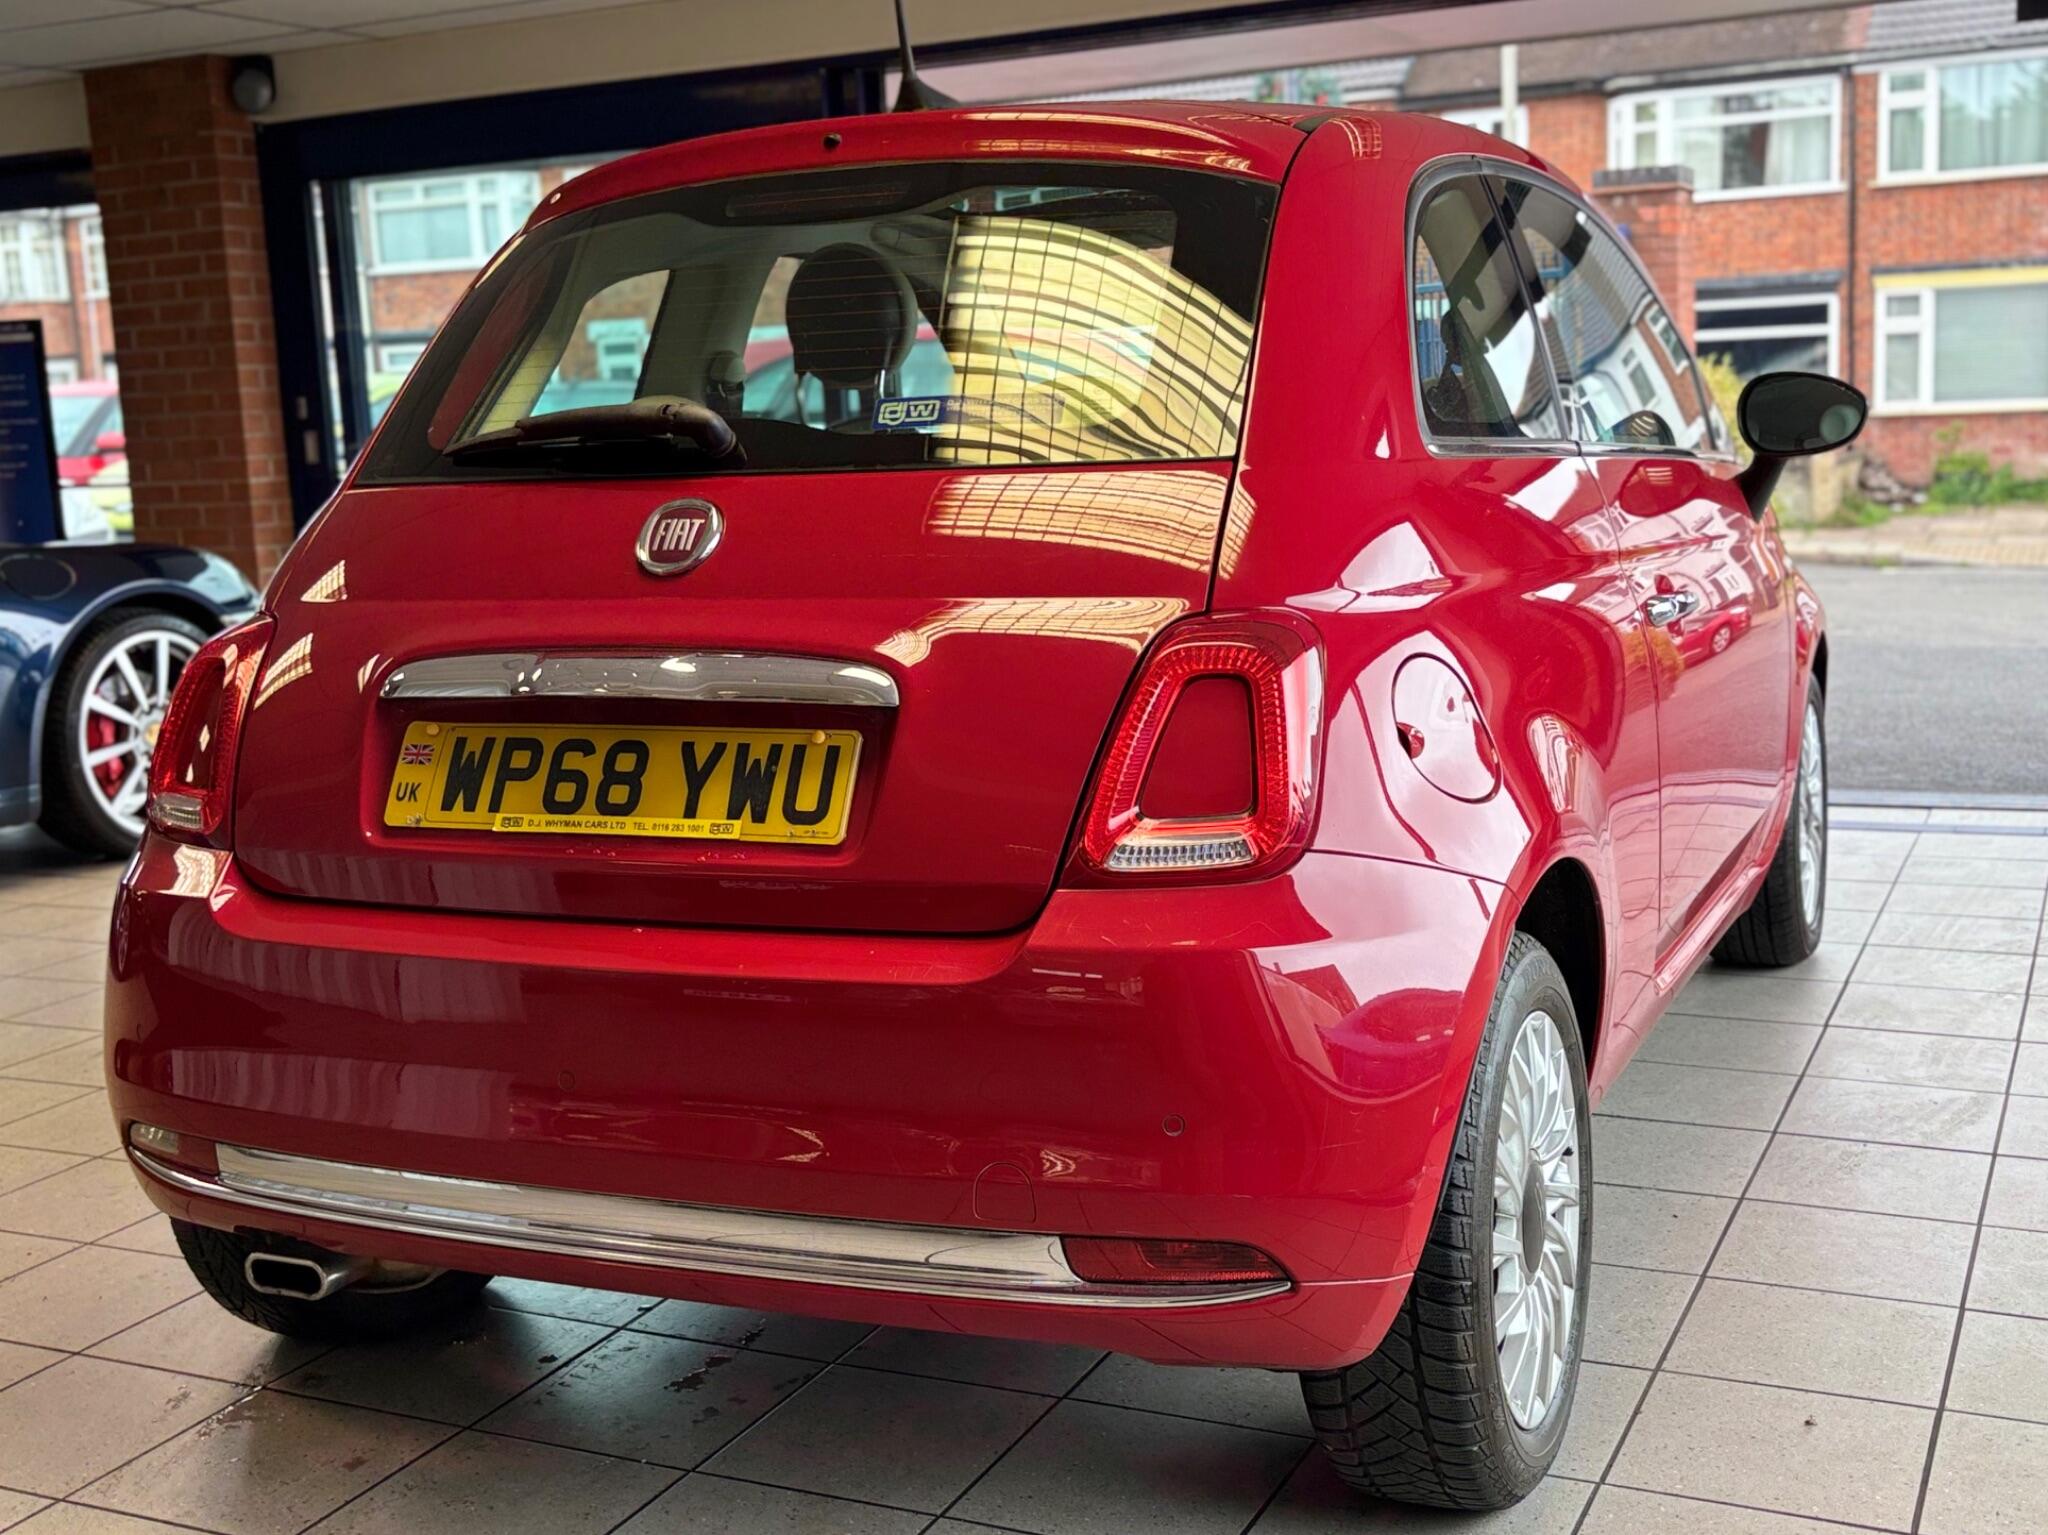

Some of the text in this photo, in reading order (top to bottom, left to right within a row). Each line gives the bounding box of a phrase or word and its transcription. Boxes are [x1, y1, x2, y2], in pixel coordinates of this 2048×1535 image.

[651, 518, 706, 551] FIAT
[396, 782, 422, 802] UK
[440, 736, 841, 825] WP68 YWU
[544, 820, 582, 829] WHYMAN
[584, 821, 609, 829] CARS
[610, 821, 626, 830] LTD
